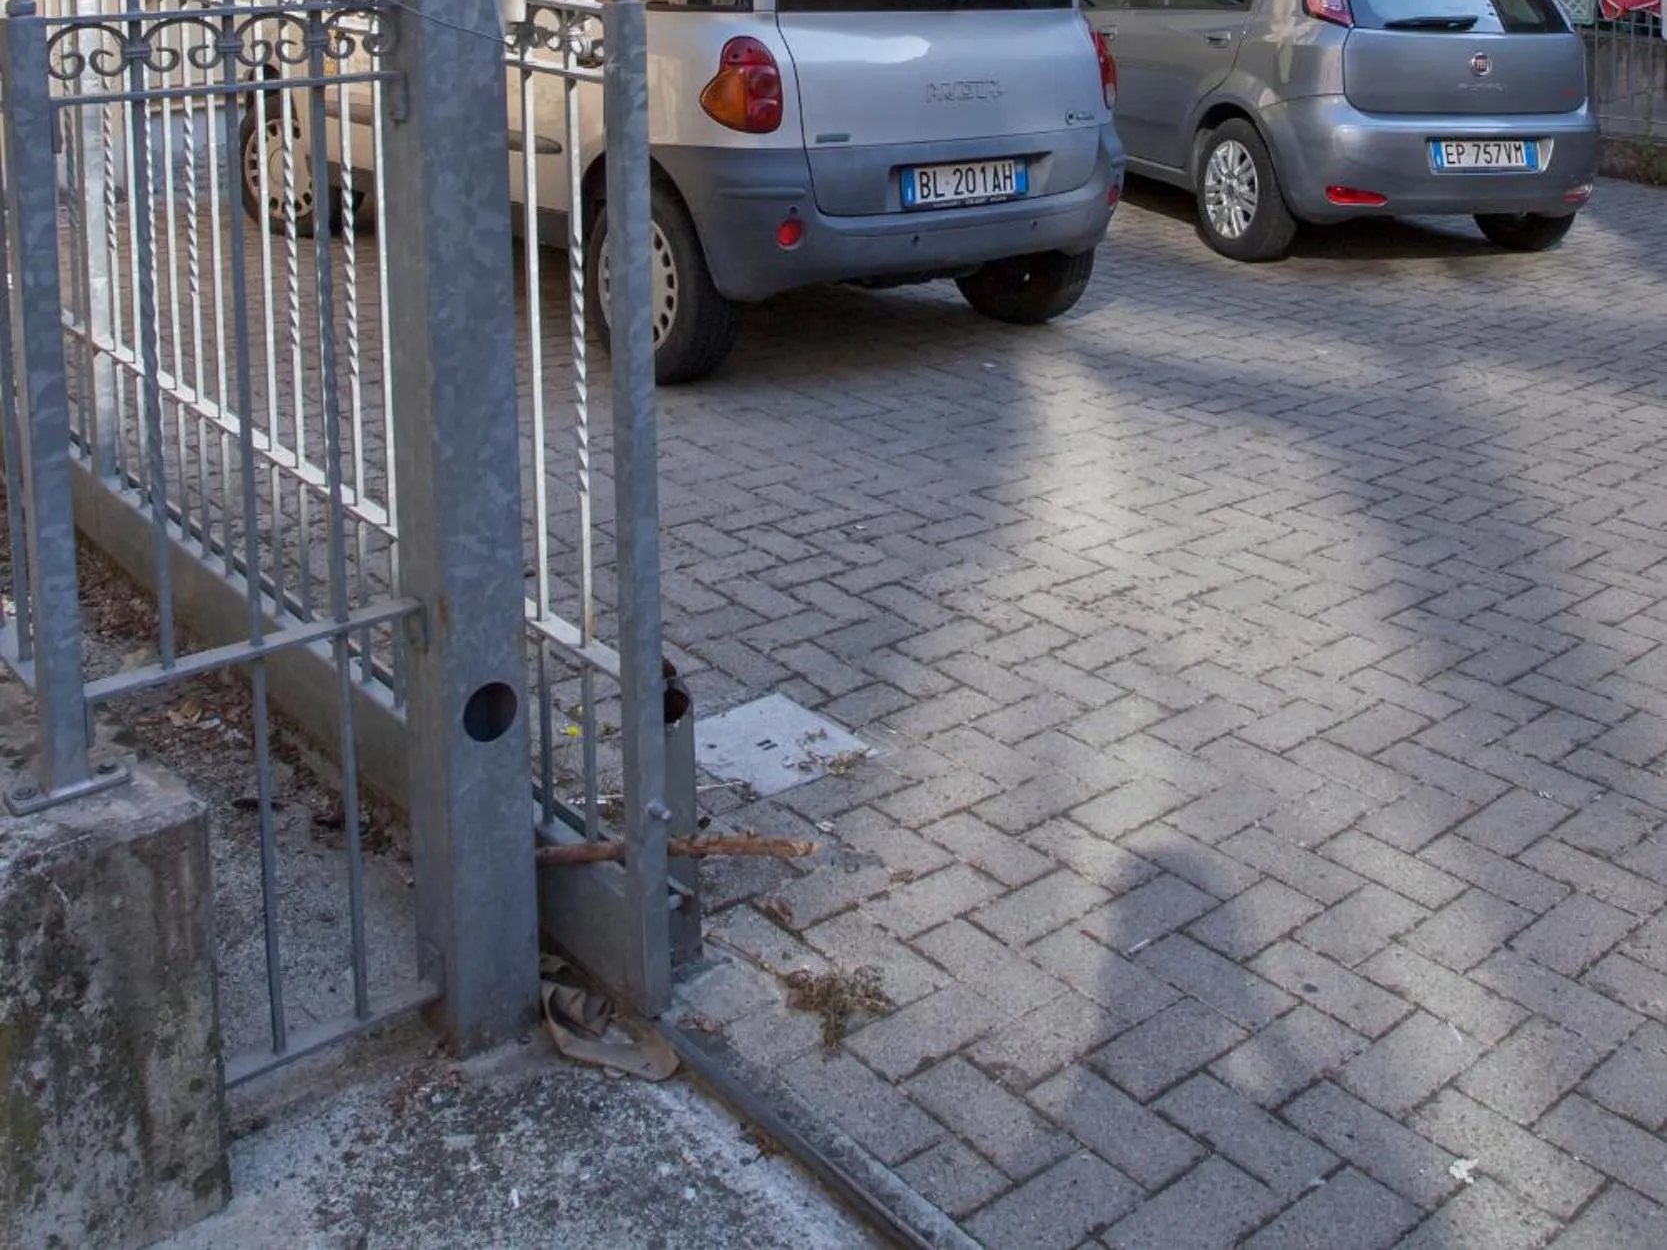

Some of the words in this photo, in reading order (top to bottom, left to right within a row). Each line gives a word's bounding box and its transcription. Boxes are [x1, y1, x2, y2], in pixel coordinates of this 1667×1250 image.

[1445, 144, 1465, 164] EP
[919, 170, 945, 199] BL
[953, 164, 1013, 195] 201AH
